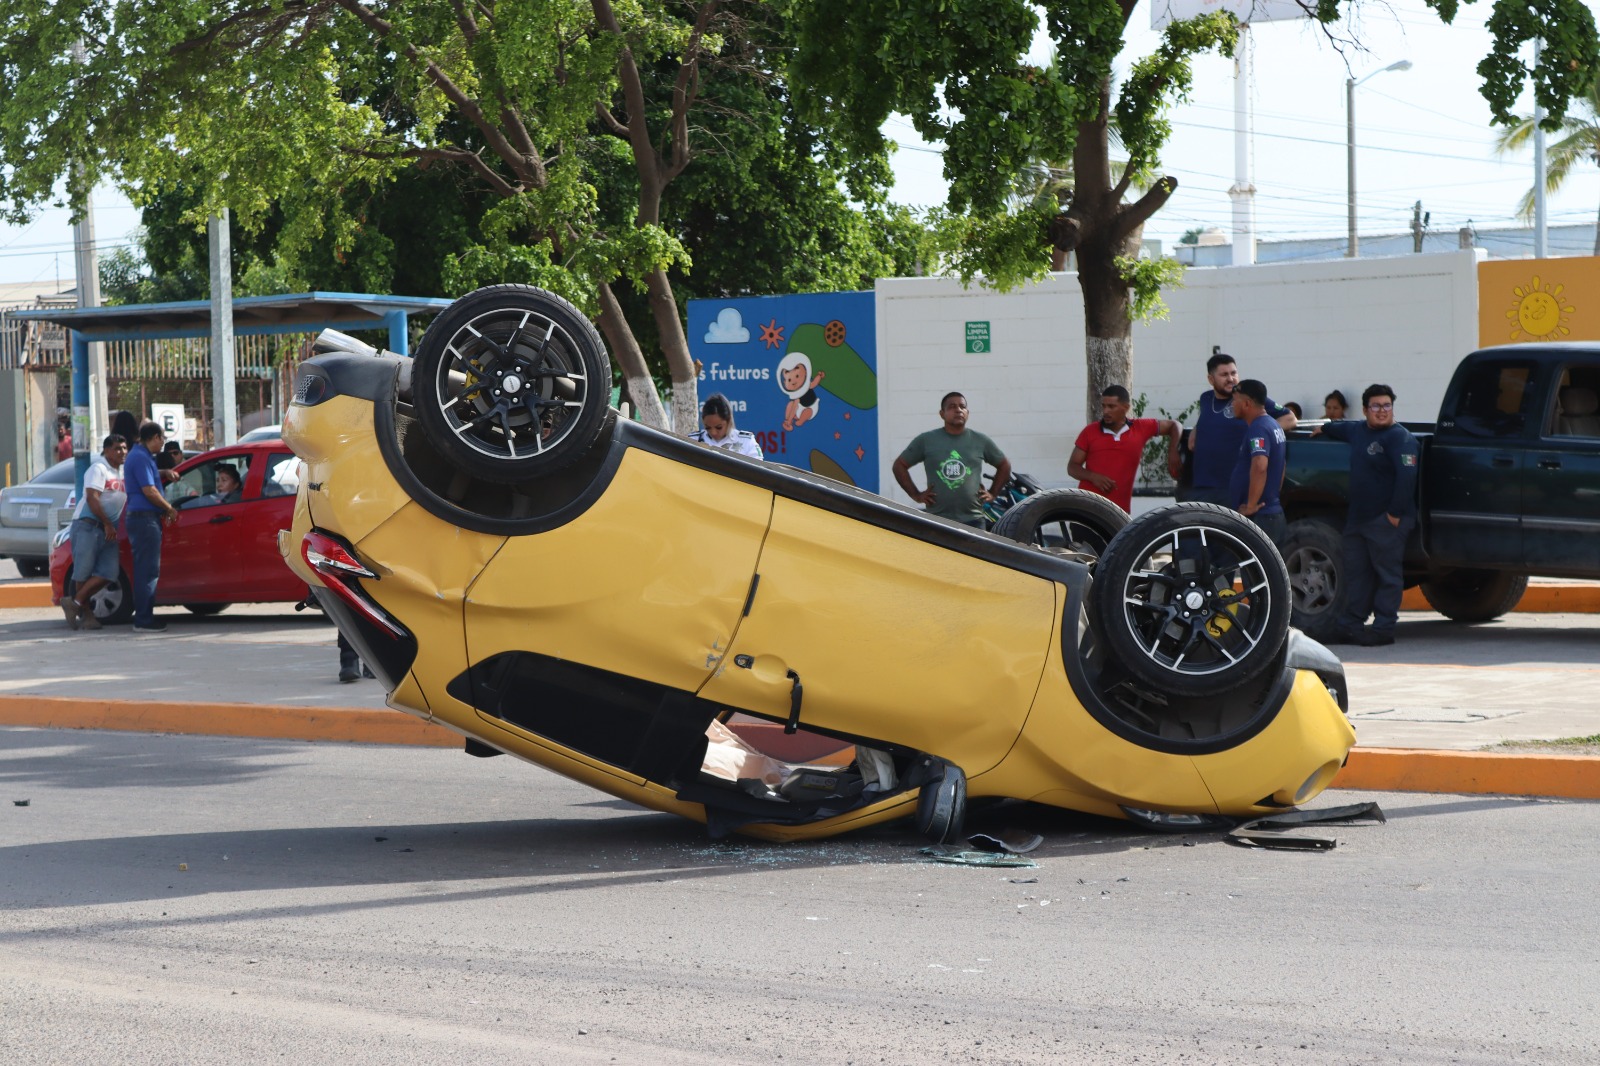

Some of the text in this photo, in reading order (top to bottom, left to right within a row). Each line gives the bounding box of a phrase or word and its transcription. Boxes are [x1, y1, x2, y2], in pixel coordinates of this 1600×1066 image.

[710, 362, 770, 381] futuros
[163, 415, 175, 432] E
[755, 431, 786, 454] OS!
